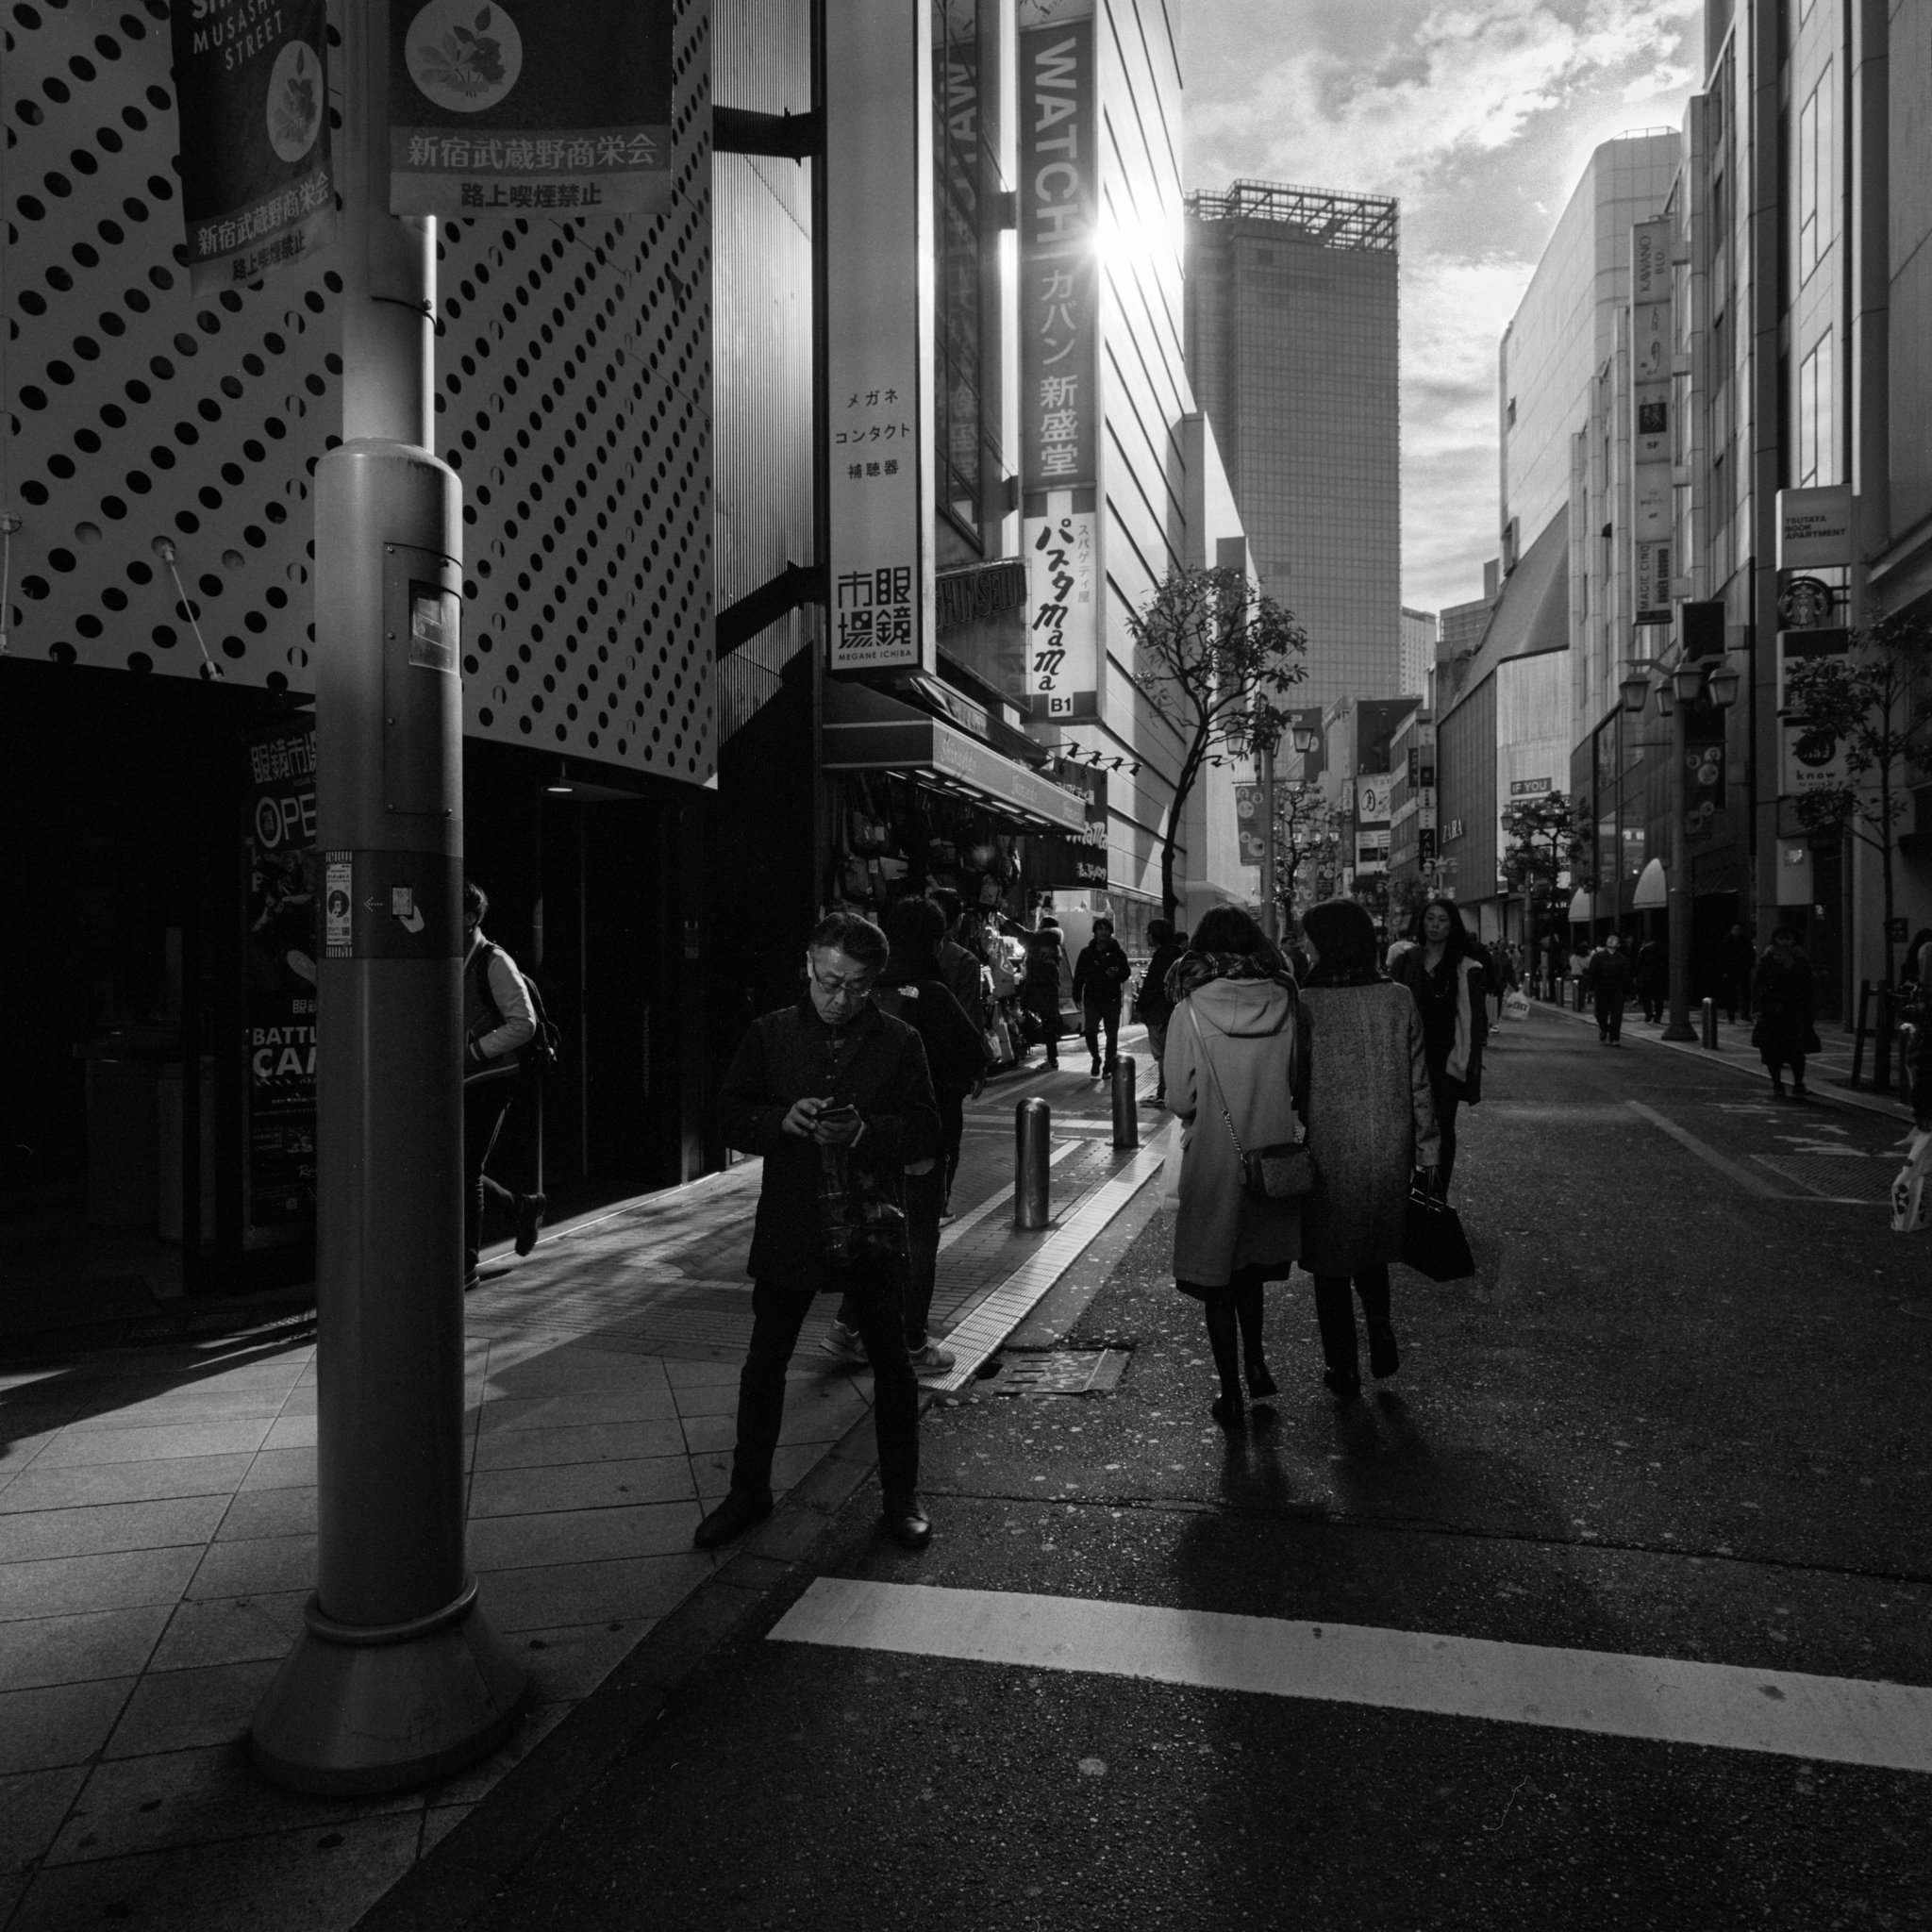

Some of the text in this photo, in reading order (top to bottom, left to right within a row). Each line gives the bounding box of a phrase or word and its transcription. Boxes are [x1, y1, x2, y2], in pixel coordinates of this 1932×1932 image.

[193, 0, 275, 55] MUSASH
[225, 9, 282, 71] STREET
[408, 132, 658, 171] 新宿武蔵野商栄会
[1035, 37, 1078, 244] WATCH
[460, 181, 603, 208] 路上喫煙禁止
[197, 171, 329, 257] 新宿武蔵野商栄会
[231, 229, 307, 282] 路上喫煙禁止
[1640, 235, 1651, 292] KAWANO
[1041, 270, 1077, 366] カバン
[846, 389, 900, 408] メガネ
[835, 423, 912, 445] コンタクト
[1040, 375, 1079, 477] 新盛堂
[847, 459, 900, 479] 補聴器
[1786, 515, 1827, 525] TSUTAYA
[1785, 528, 1846, 541] APARTMENT
[1640, 575, 1650, 609] MAGIC
[839, 649, 912, 660] MEGANE ICHIBA
[1050, 697, 1073, 712] B1
[1512, 780, 1548, 793] IF YOU
[1796, 770, 1836, 781] know
[255, 792, 317, 848] OPE
[1441, 818, 1463, 844] ZARA
[1423, 831, 1432, 858] ZAR
[252, 1025, 317, 1046] BATTL
